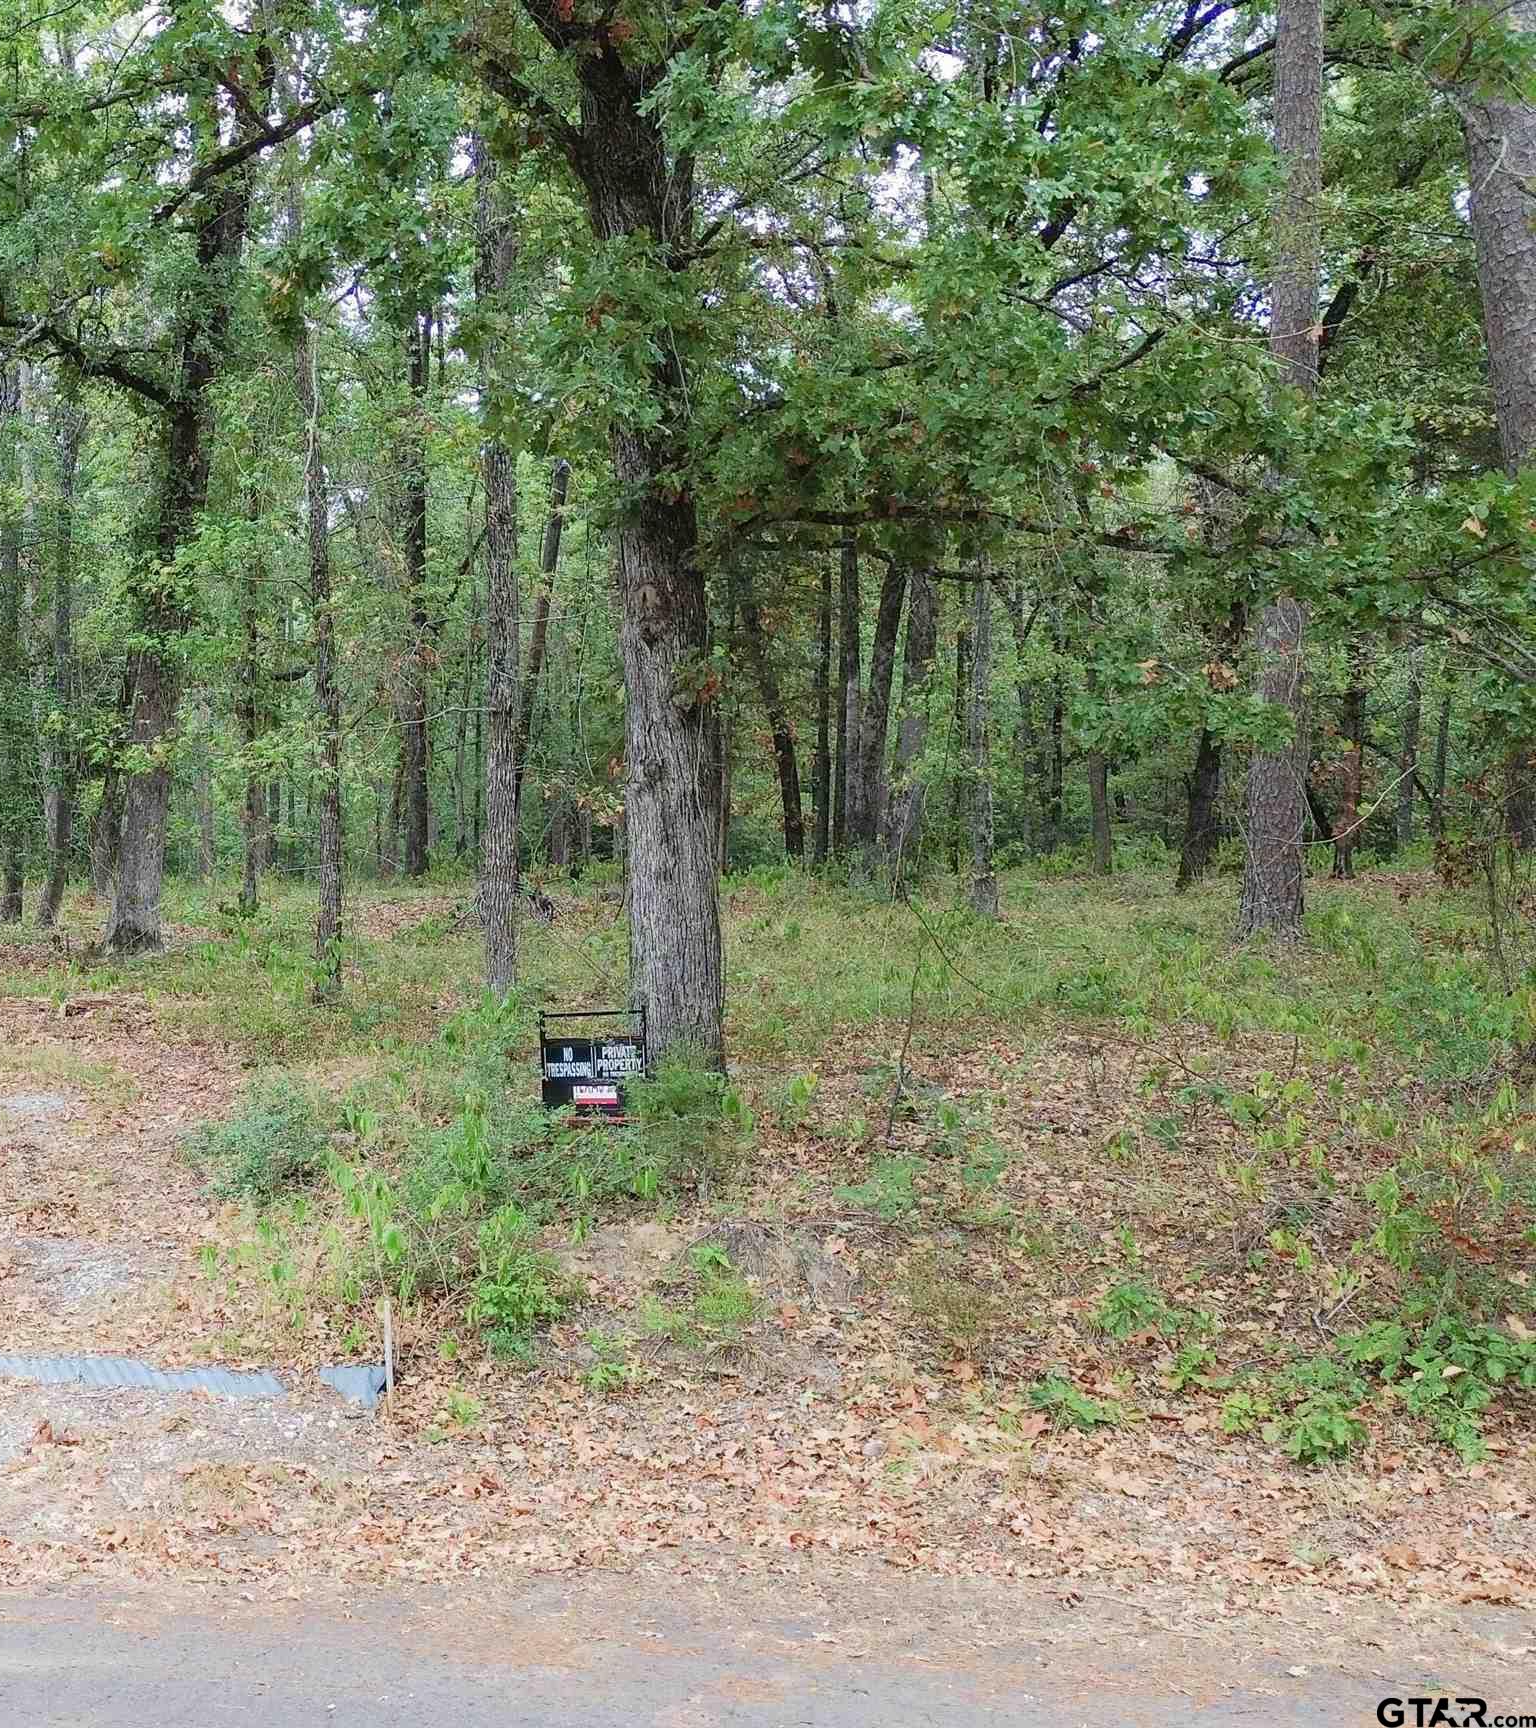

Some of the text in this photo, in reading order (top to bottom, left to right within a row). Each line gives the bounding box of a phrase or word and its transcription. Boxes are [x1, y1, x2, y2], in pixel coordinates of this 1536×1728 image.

[563, 1046, 573, 1062] NO
[602, 1045, 636, 1059] PRIVATE
[547, 1062, 592, 1078] TRESPASSING
[597, 1058, 642, 1071] PROPERTY
